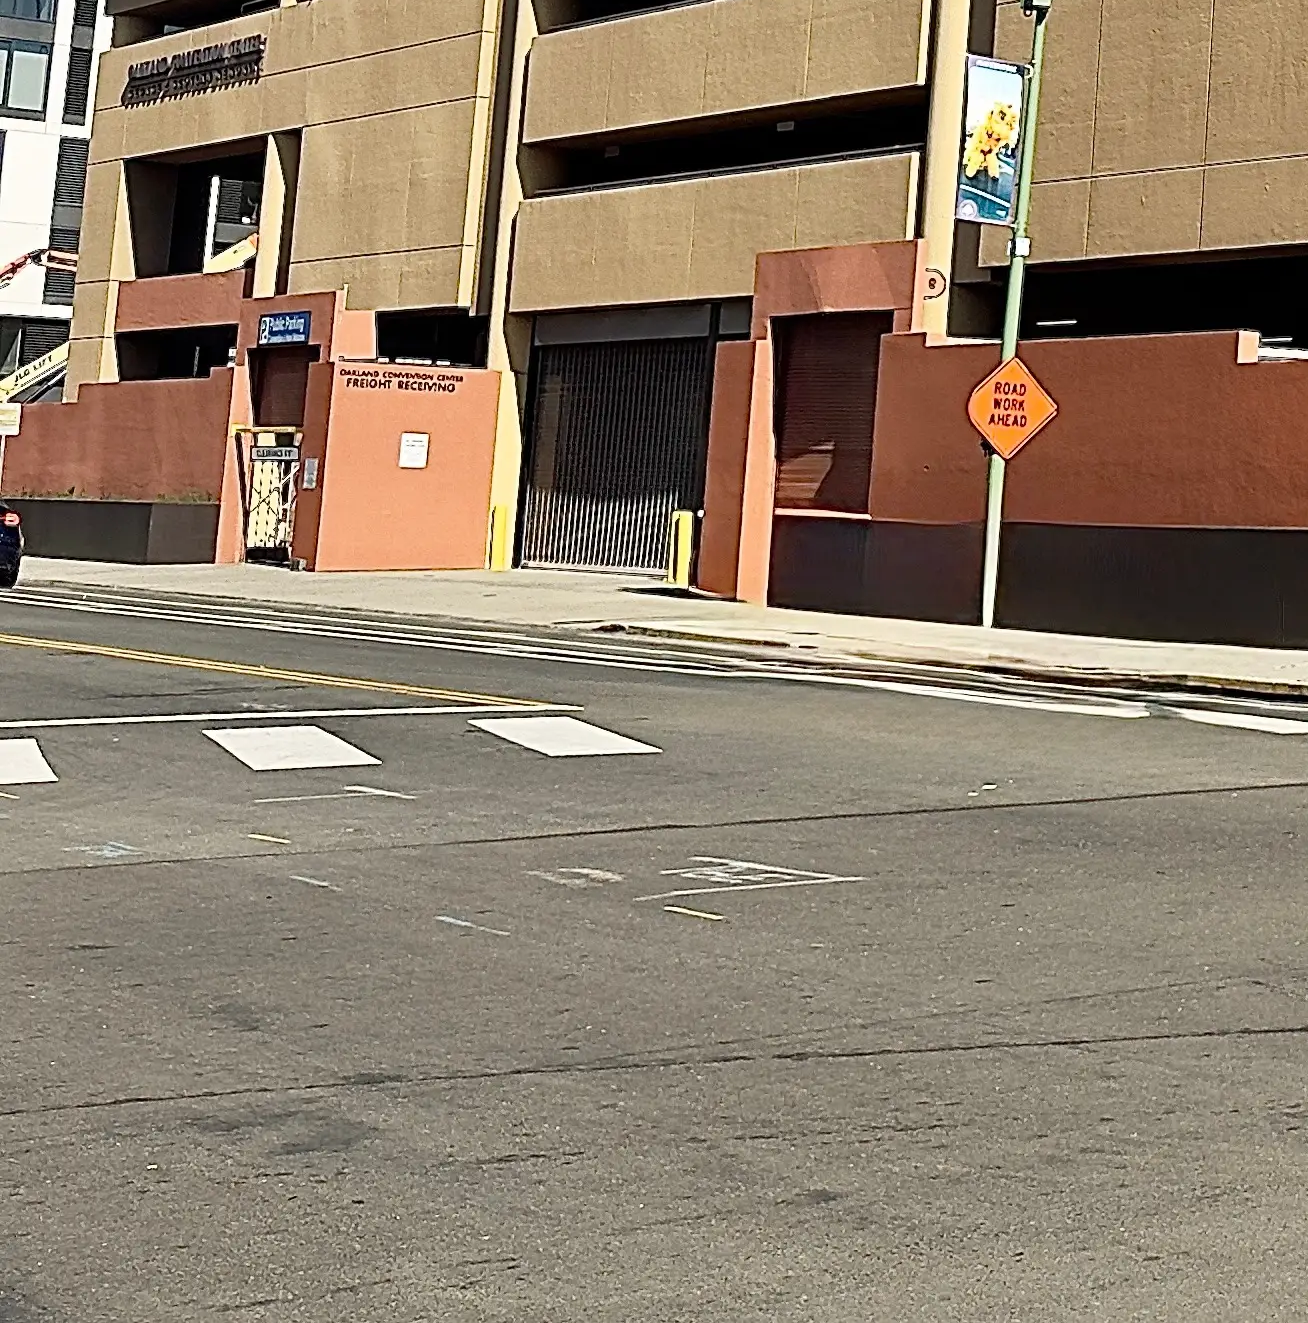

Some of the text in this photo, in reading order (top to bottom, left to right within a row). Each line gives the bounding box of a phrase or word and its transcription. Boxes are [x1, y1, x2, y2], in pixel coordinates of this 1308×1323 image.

[339, 368, 464, 382] OAKLAND CONVENTION CENTER
[345, 377, 456, 393] FREIGHT RECEIVING
[994, 381, 1027, 396] ROAD
[993, 397, 1025, 412] WORK
[988, 413, 1028, 428] AHEAD
